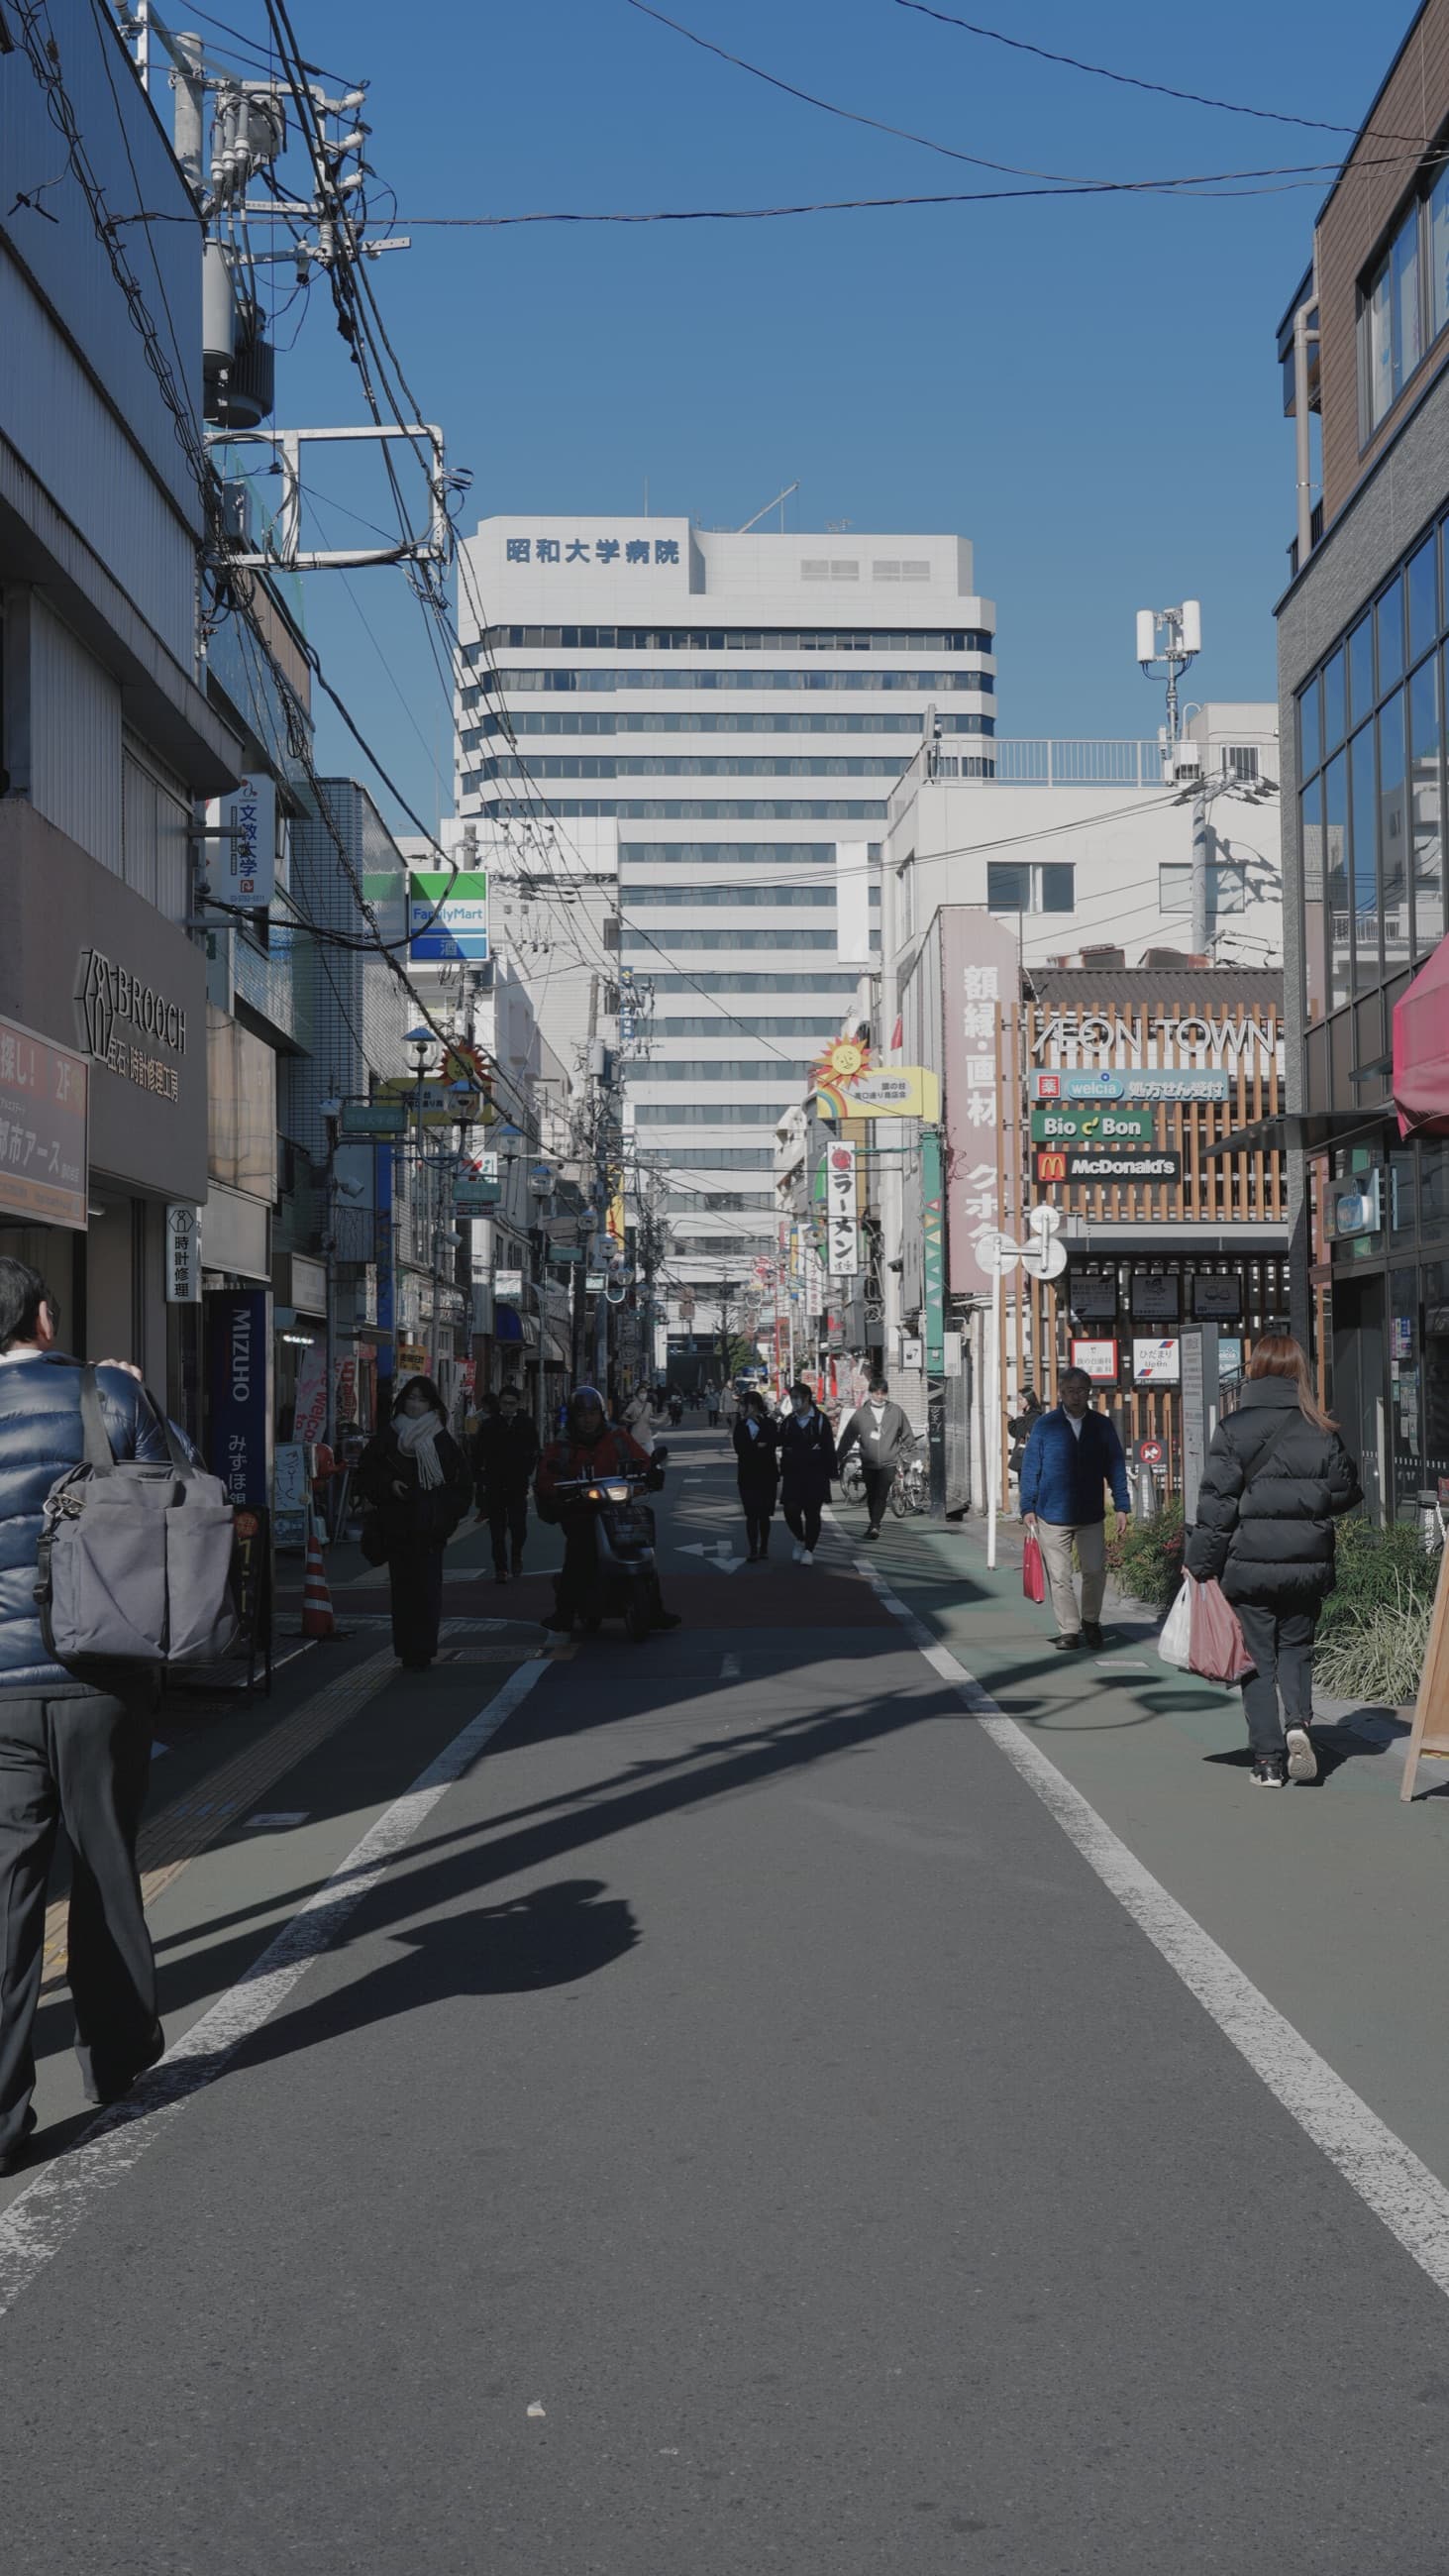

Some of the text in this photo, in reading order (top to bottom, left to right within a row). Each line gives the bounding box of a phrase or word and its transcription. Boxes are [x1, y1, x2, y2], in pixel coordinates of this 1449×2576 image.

[506, 538, 679, 565] 昭和大学病院
[117, 966, 186, 1054] BROOCH
[964, 965, 998, 1127] 額縁・画材
[1155, 1018, 1274, 1055] TOWN
[55, 1060, 70, 1103] 2F
[1041, 1078, 1058, 1095] 薬
[1071, 1085, 1117, 1096] welcia
[1128, 1082, 1224, 1100] 処方せん受付
[1044, 1118, 1077, 1135] Bio
[1102, 1118, 1141, 1135] Bon
[1071, 1159, 1176, 1175] McDonald's
[832, 1173, 854, 1258] ラーメン
[174, 1236, 189, 1298] 時計修理
[232, 1309, 252, 1402] MIZUHO
